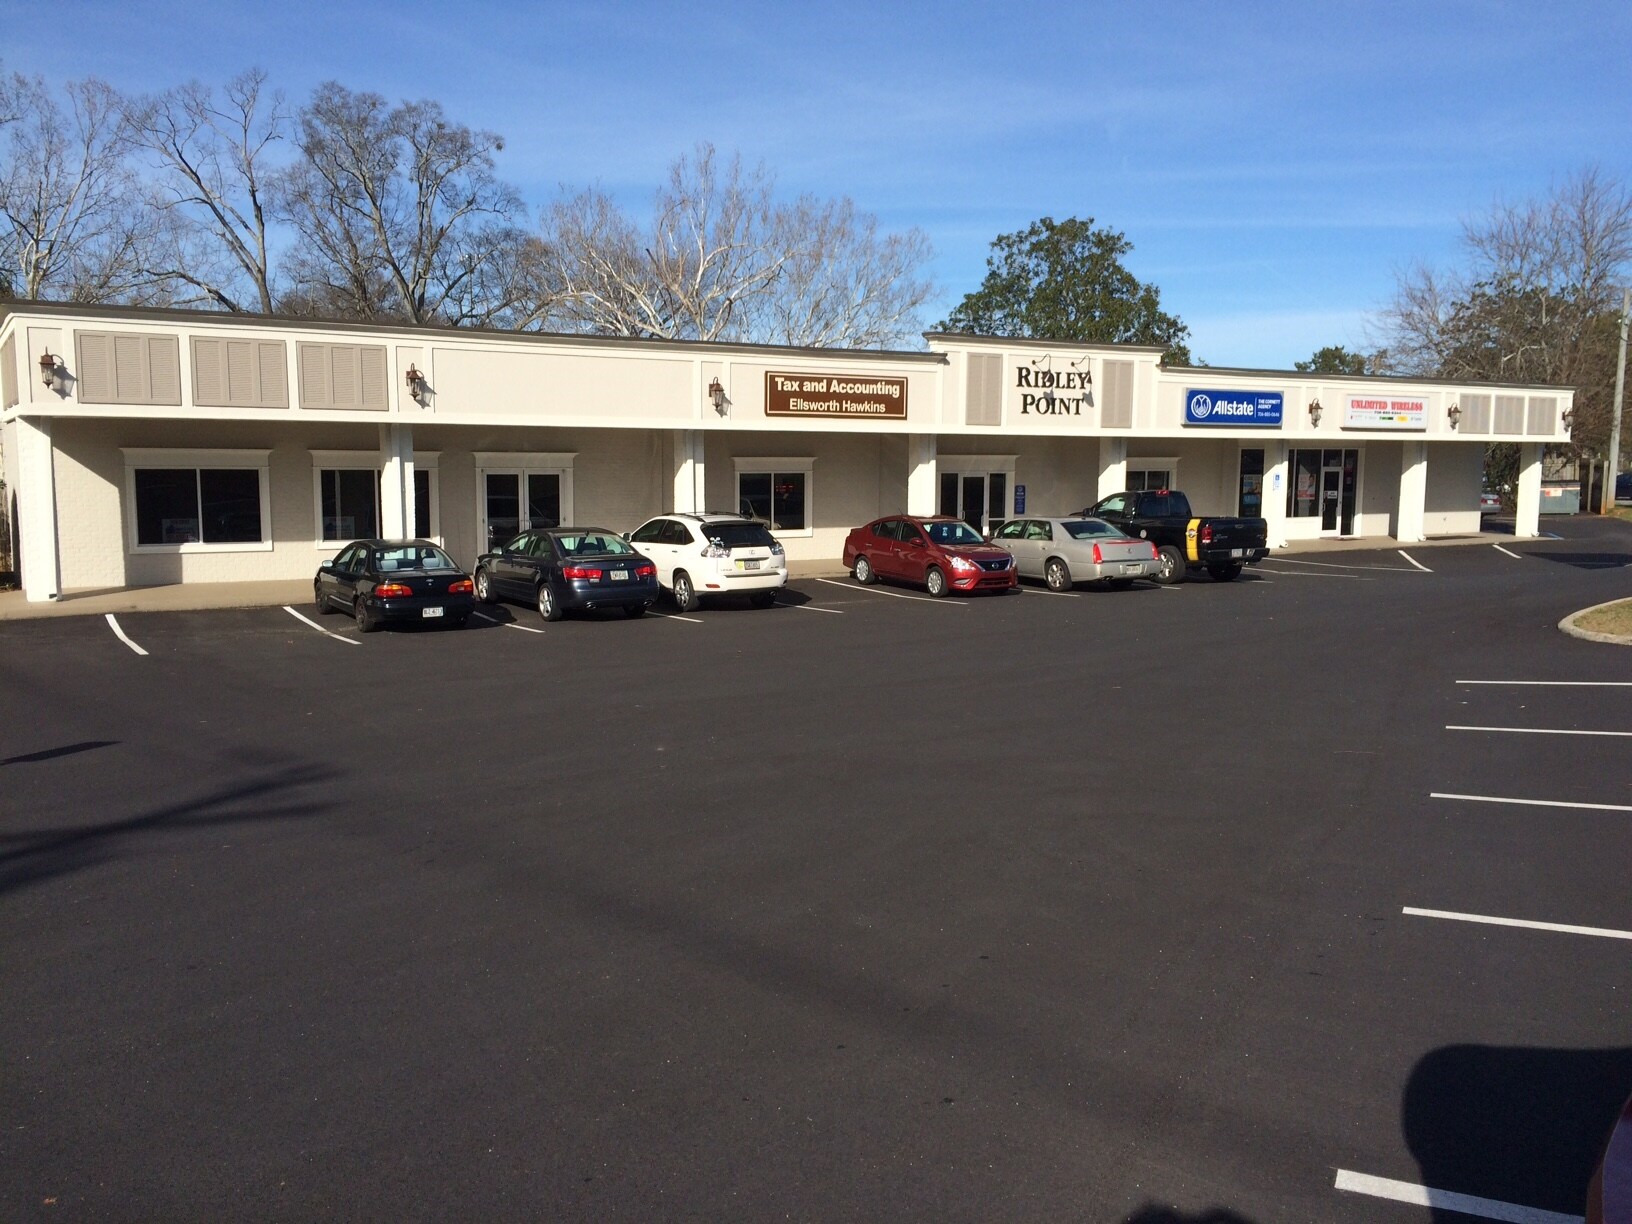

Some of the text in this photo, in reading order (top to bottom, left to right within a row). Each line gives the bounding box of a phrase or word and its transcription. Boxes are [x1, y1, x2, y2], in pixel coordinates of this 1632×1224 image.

[1016, 366, 1090, 390] RIDLEY
[775, 377, 900, 398] Tax and Accounting
[789, 398, 886, 413] Ellsworth Hawkins
[1021, 393, 1085, 415] POINT
[1212, 400, 1254, 415] Allstate
[1351, 399, 1387, 410] UNLIMITED
